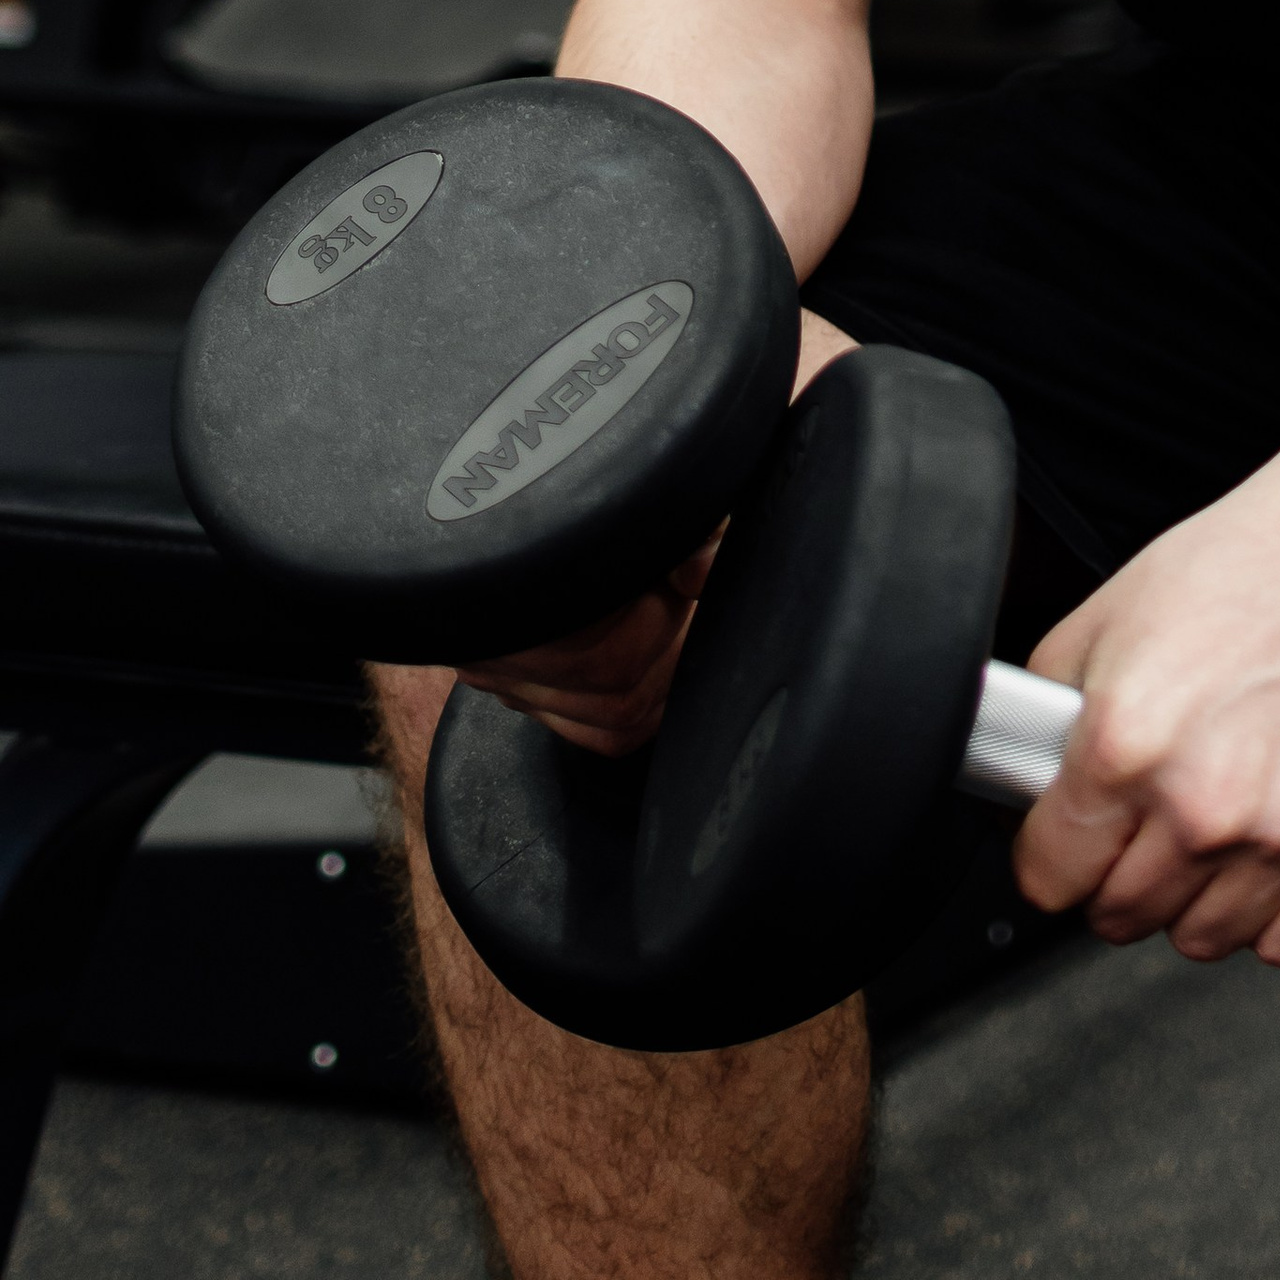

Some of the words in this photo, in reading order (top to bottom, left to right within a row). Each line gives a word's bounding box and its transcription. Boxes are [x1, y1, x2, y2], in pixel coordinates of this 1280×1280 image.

[362, 185, 408, 223] 8
[299, 216, 377, 273] kg
[442, 295, 679, 507] FOREMAN
